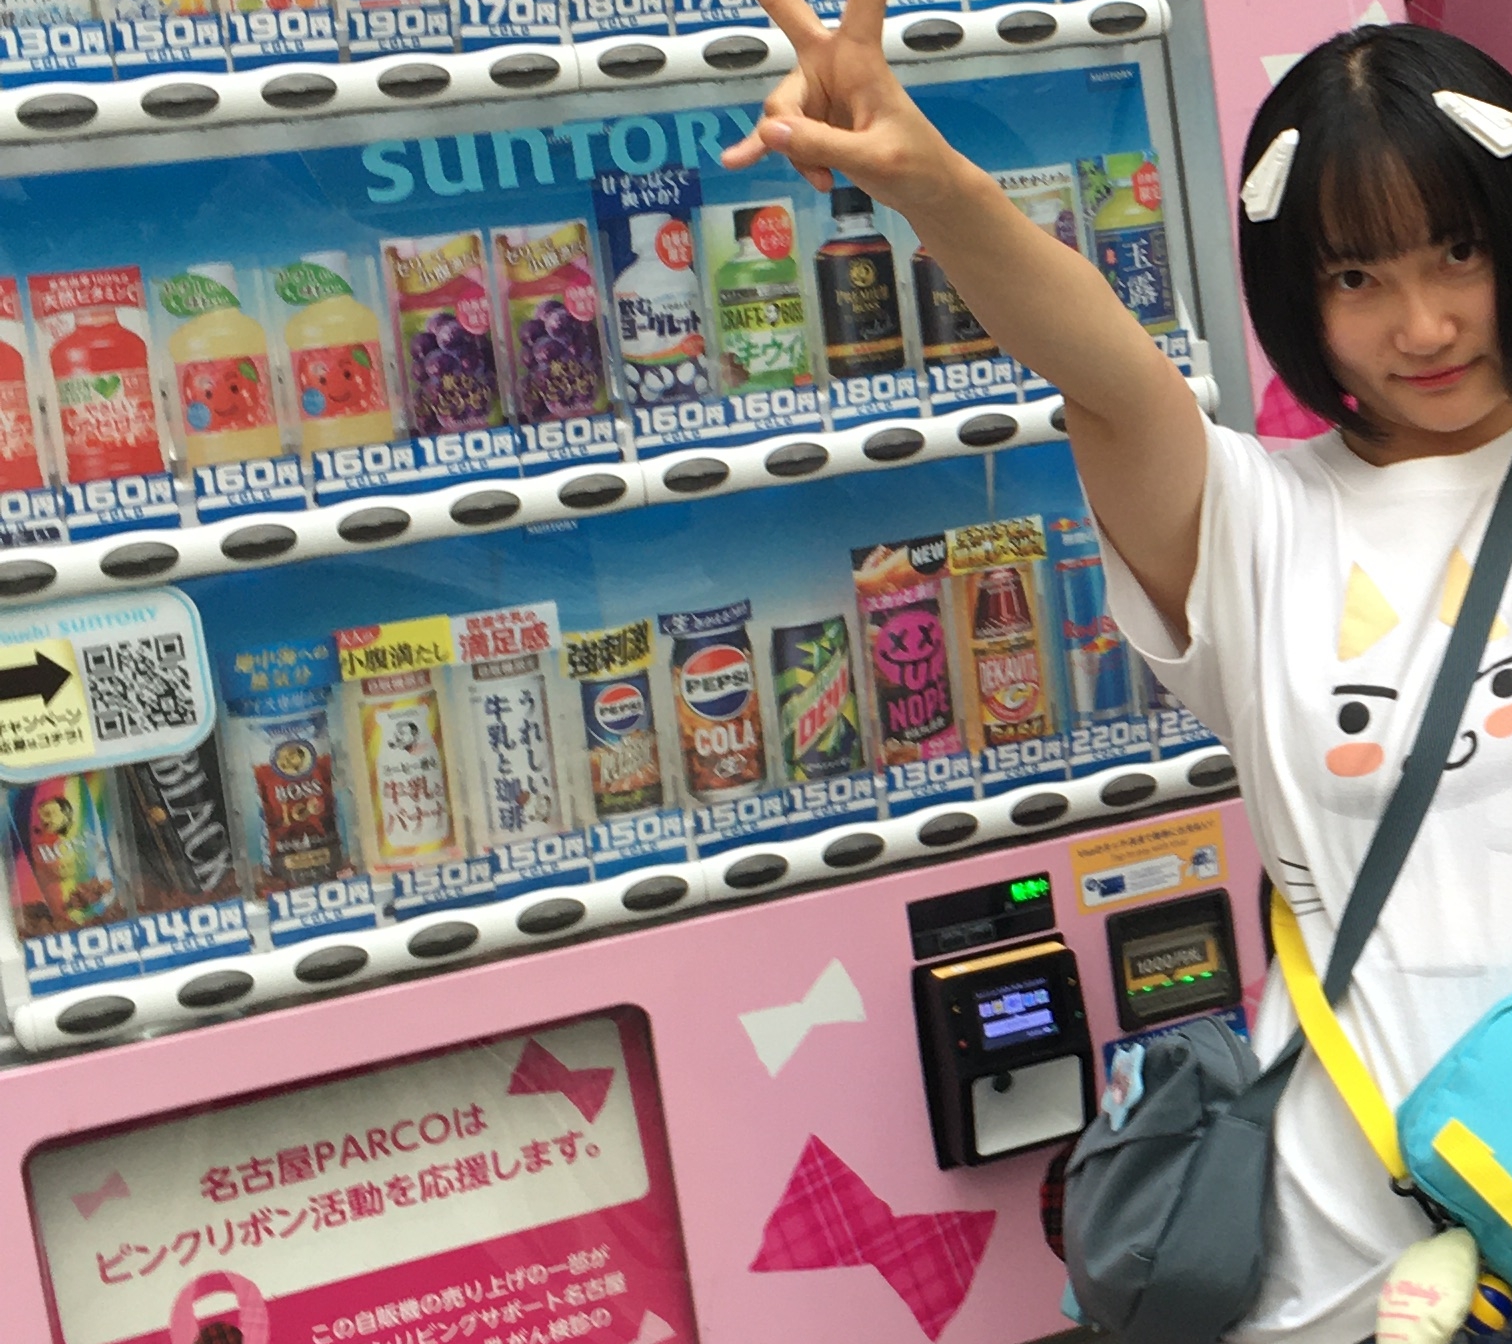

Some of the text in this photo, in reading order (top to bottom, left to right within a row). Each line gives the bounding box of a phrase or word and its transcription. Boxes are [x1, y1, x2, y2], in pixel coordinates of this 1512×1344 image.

[911, 540, 947, 566] NEW
[0, 606, 158, 645] ouch! SUNTORY
[684, 667, 750, 696] PEPSI
[518, 688, 550, 796] うれしい
[694, 720, 758, 758] COLA
[149, 751, 232, 893] BLACK
[199, 1101, 489, 1204] 名古屋PARCOは
[94, 1129, 603, 1287] ピンクリボン活動を応援します。
